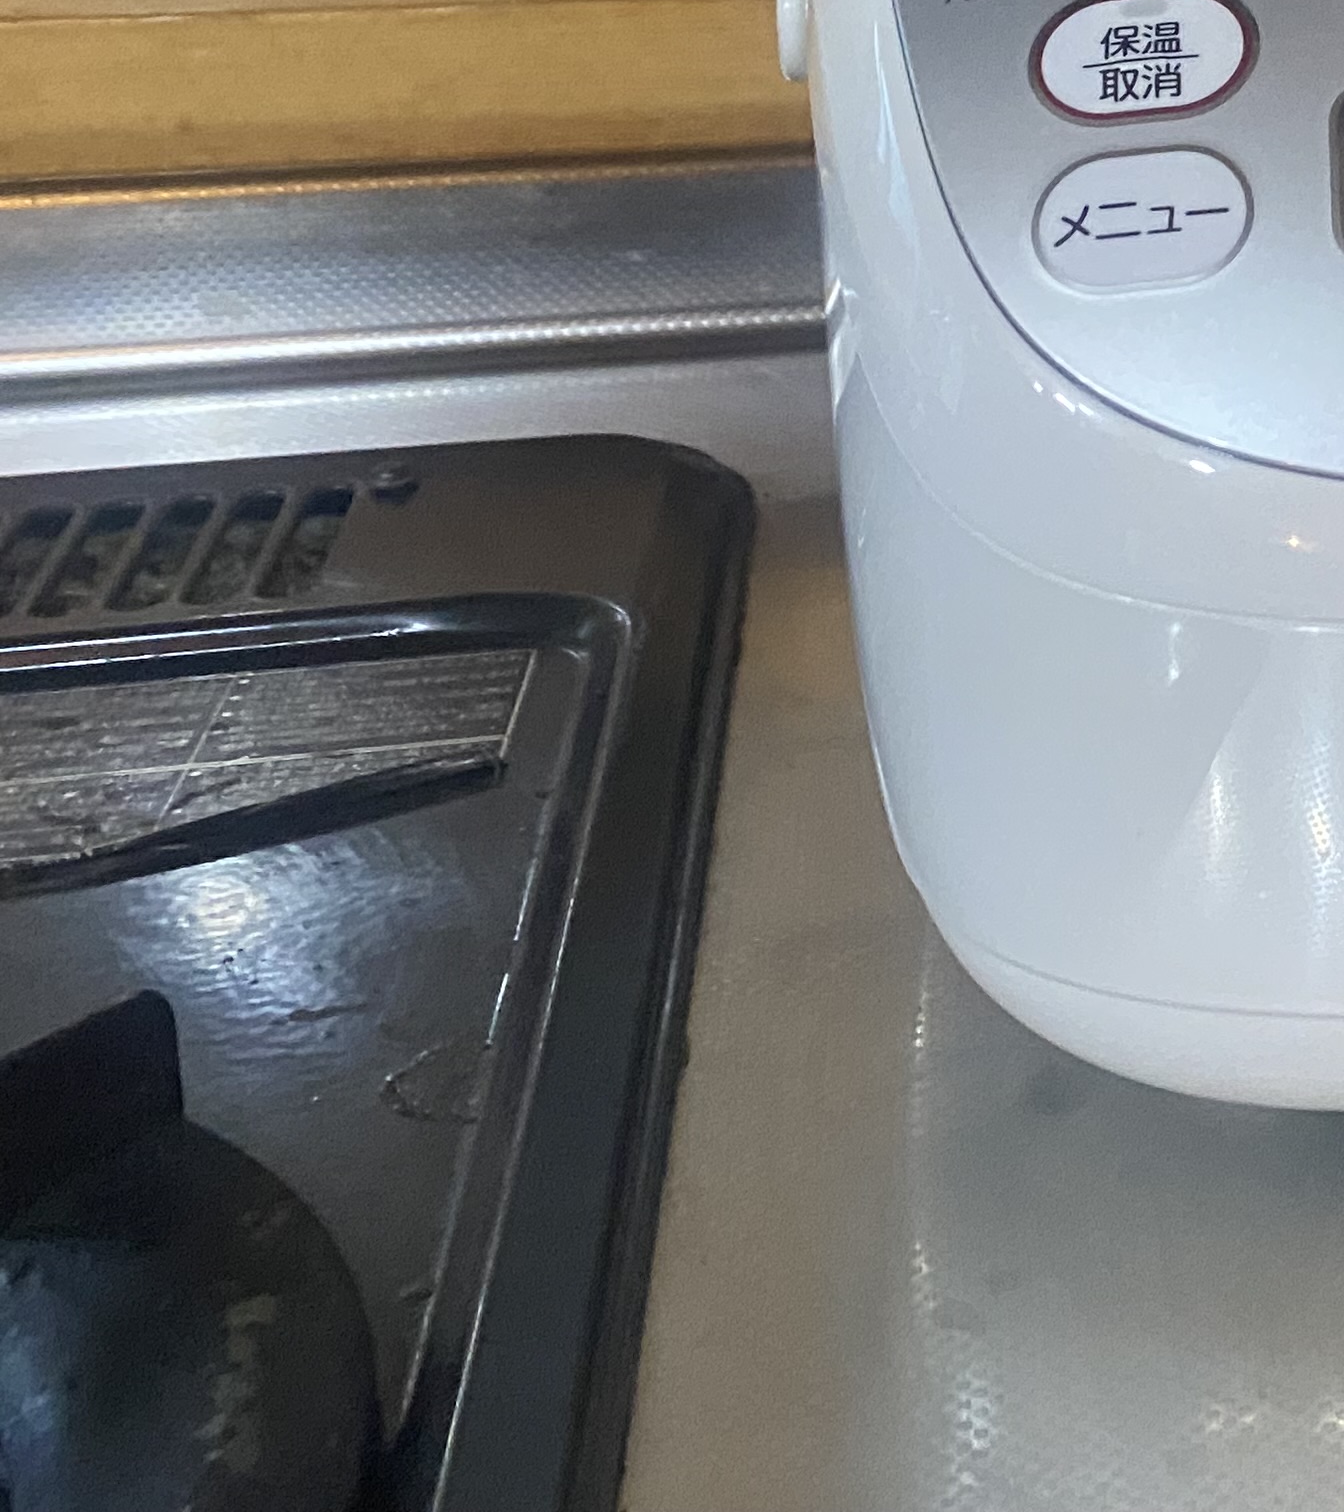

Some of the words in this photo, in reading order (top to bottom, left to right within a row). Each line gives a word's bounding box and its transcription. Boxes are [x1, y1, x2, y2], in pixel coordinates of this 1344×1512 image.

[1099, 21, 1182, 59] 保温
[1099, 63, 1183, 103] 取消
[1054, 201, 1230, 248] メニュー
